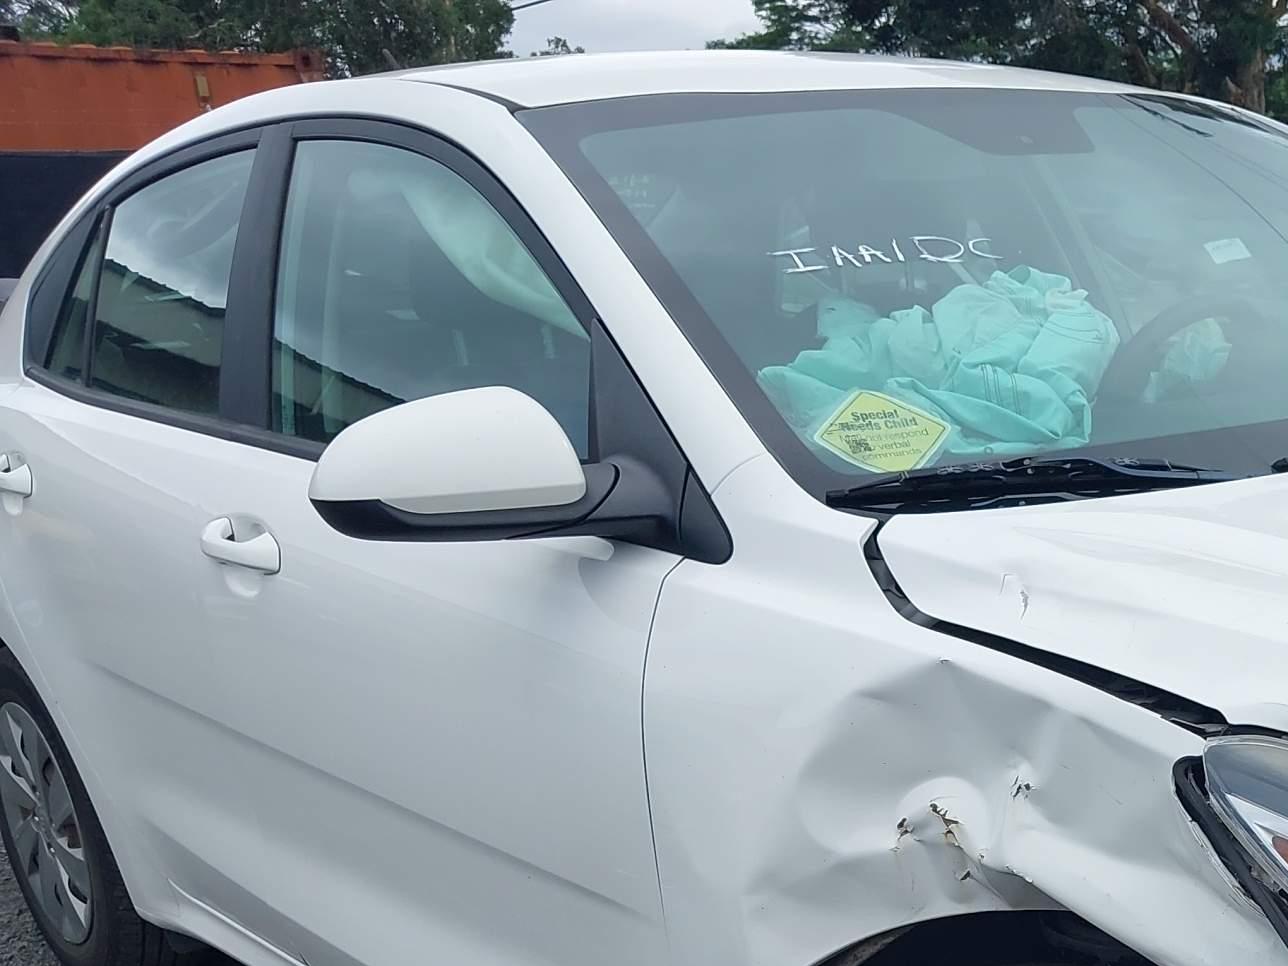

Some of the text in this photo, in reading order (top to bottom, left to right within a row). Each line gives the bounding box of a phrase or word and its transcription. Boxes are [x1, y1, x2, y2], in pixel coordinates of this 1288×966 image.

[851, 409, 899, 422] Special
[884, 416, 918, 429] Child
[878, 440, 911, 450] verbal
